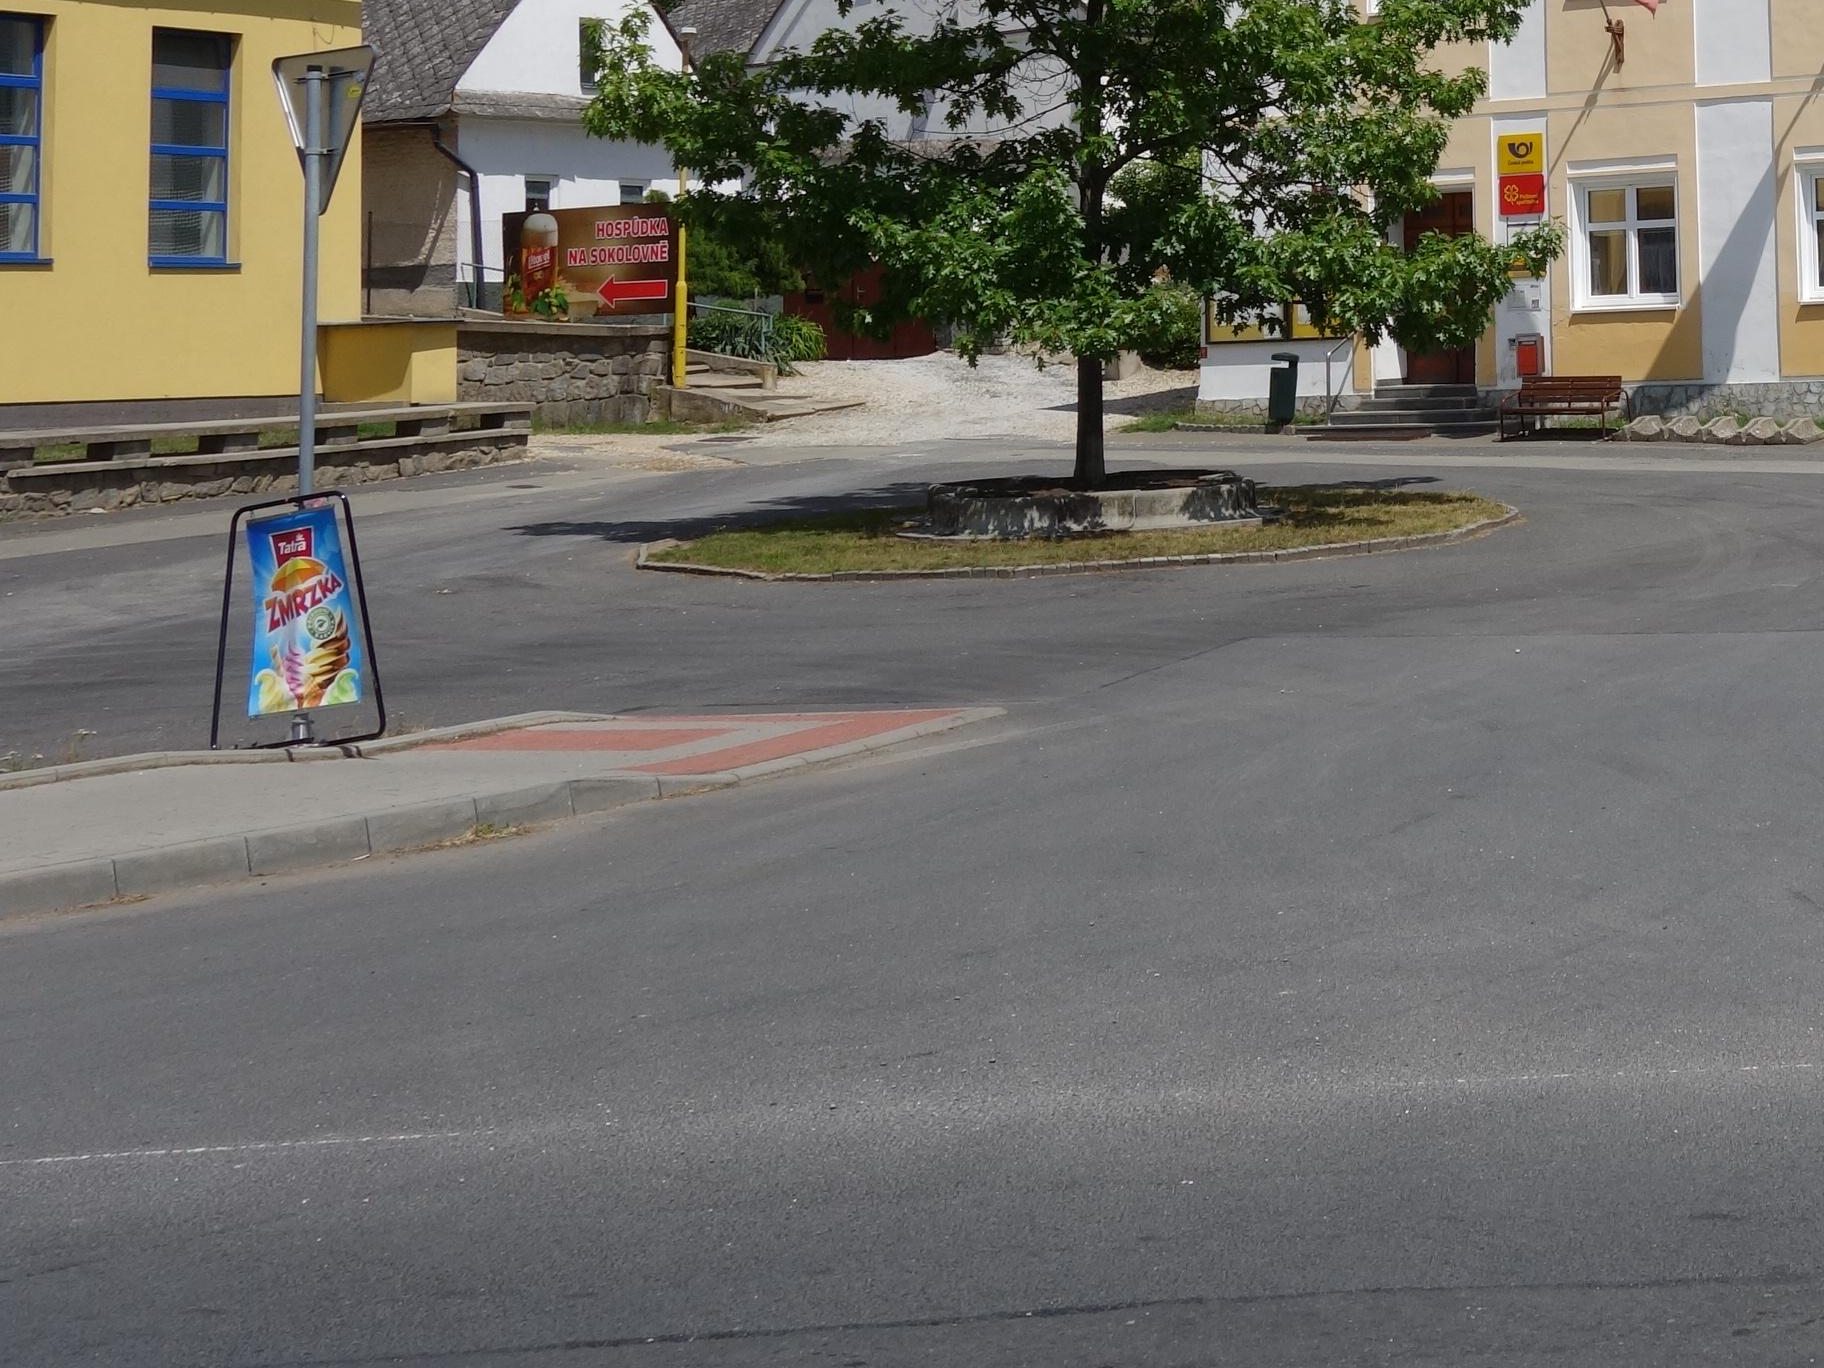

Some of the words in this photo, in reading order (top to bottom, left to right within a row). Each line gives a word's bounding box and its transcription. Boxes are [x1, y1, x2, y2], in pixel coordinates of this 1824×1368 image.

[568, 247, 588, 267] NA
[590, 240, 669, 266] SOKOLOVNĚ
[278, 539, 307, 555] Tatra
[263, 571, 343, 633] ZMRZKA
